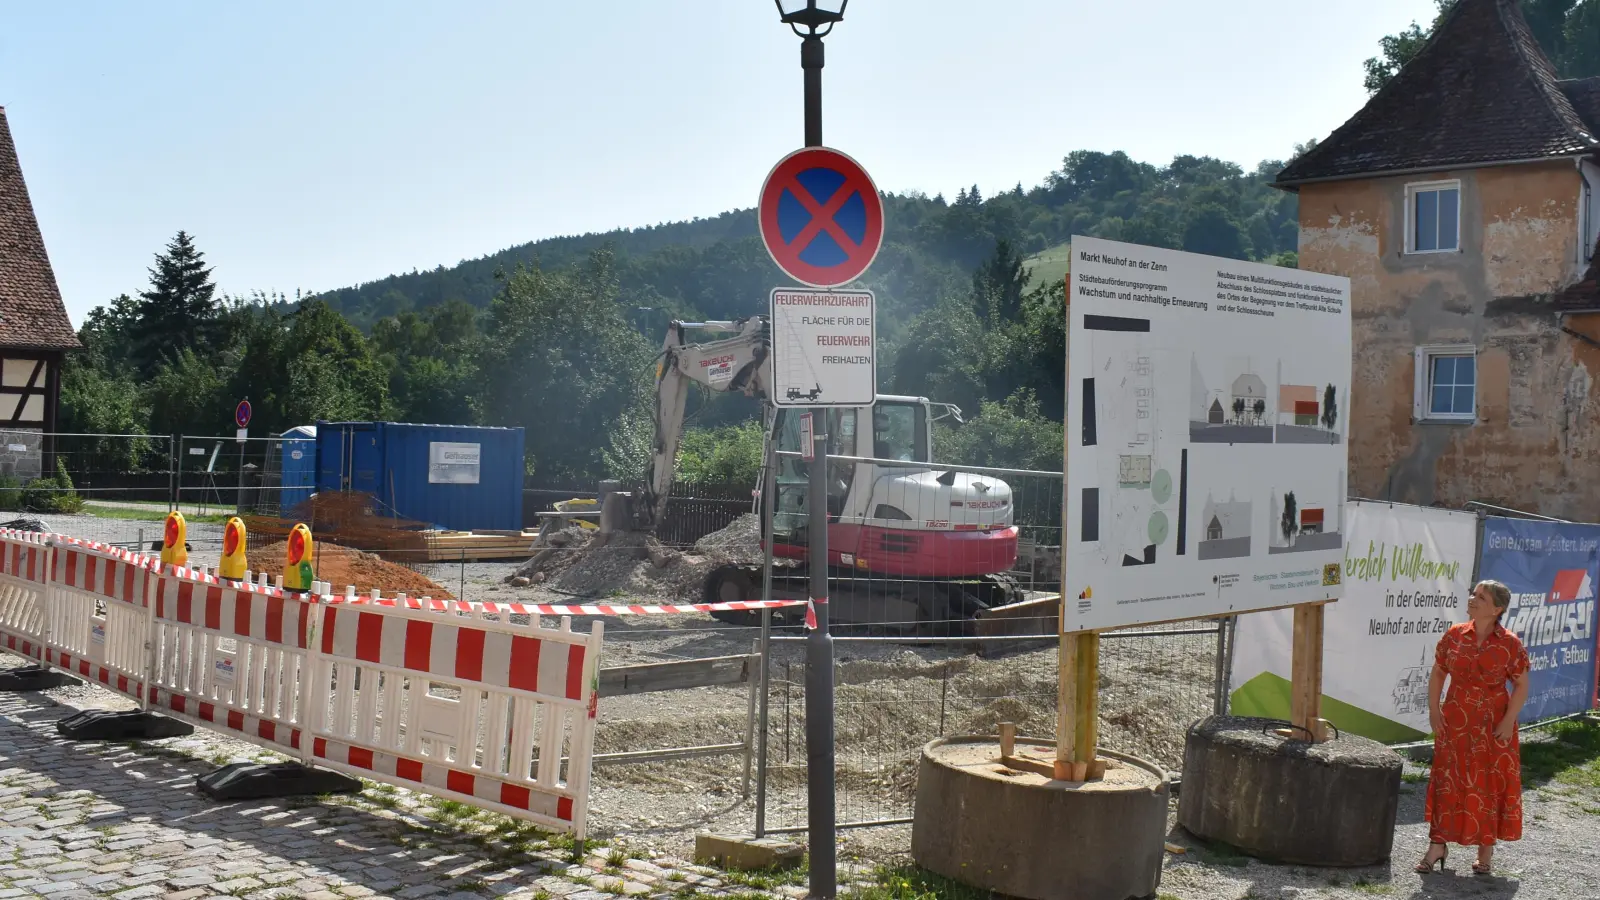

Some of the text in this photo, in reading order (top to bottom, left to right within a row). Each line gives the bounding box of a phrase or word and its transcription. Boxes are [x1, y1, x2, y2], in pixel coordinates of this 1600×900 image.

[1080, 251, 1168, 272] Markt Neuhof an der Zenn
[1079, 273, 1168, 292] Städtebauförderungsprogramm
[1217, 270, 1236, 280] Neubau
[1236, 274, 1250, 282] eines
[1078, 286, 1208, 311] Wachstum und nachhaltige Erneuerung
[1217, 281, 1243, 291] Abschluss
[1243, 284, 1252, 292] des
[1253, 285, 1287, 297] Schlossplatzes
[1287, 290, 1296, 299] und
[775, 294, 870, 307] FEUERWEHRZUFAHRT
[1217, 291, 1226, 299] des
[1227, 292, 1240, 301] Ortes
[1241, 294, 1249, 302] der
[1249, 295, 1277, 307] Begegnung
[1285, 300, 1295, 308] dem
[1227, 304, 1236, 312] der
[802, 315, 870, 326] FLÄCHE FÜR DIE
[816, 335, 870, 346] FEUERWEHR
[822, 355, 871, 364] FREIHALTEN
[1385, 588, 1458, 609] in der Gemeinde
[1368, 616, 1403, 636] Neuhof
[1403, 620, 1415, 634] an
[1416, 616, 1431, 634] der
[1550, 648, 1558, 668] &
[1560, 644, 1589, 665] Tefbau
